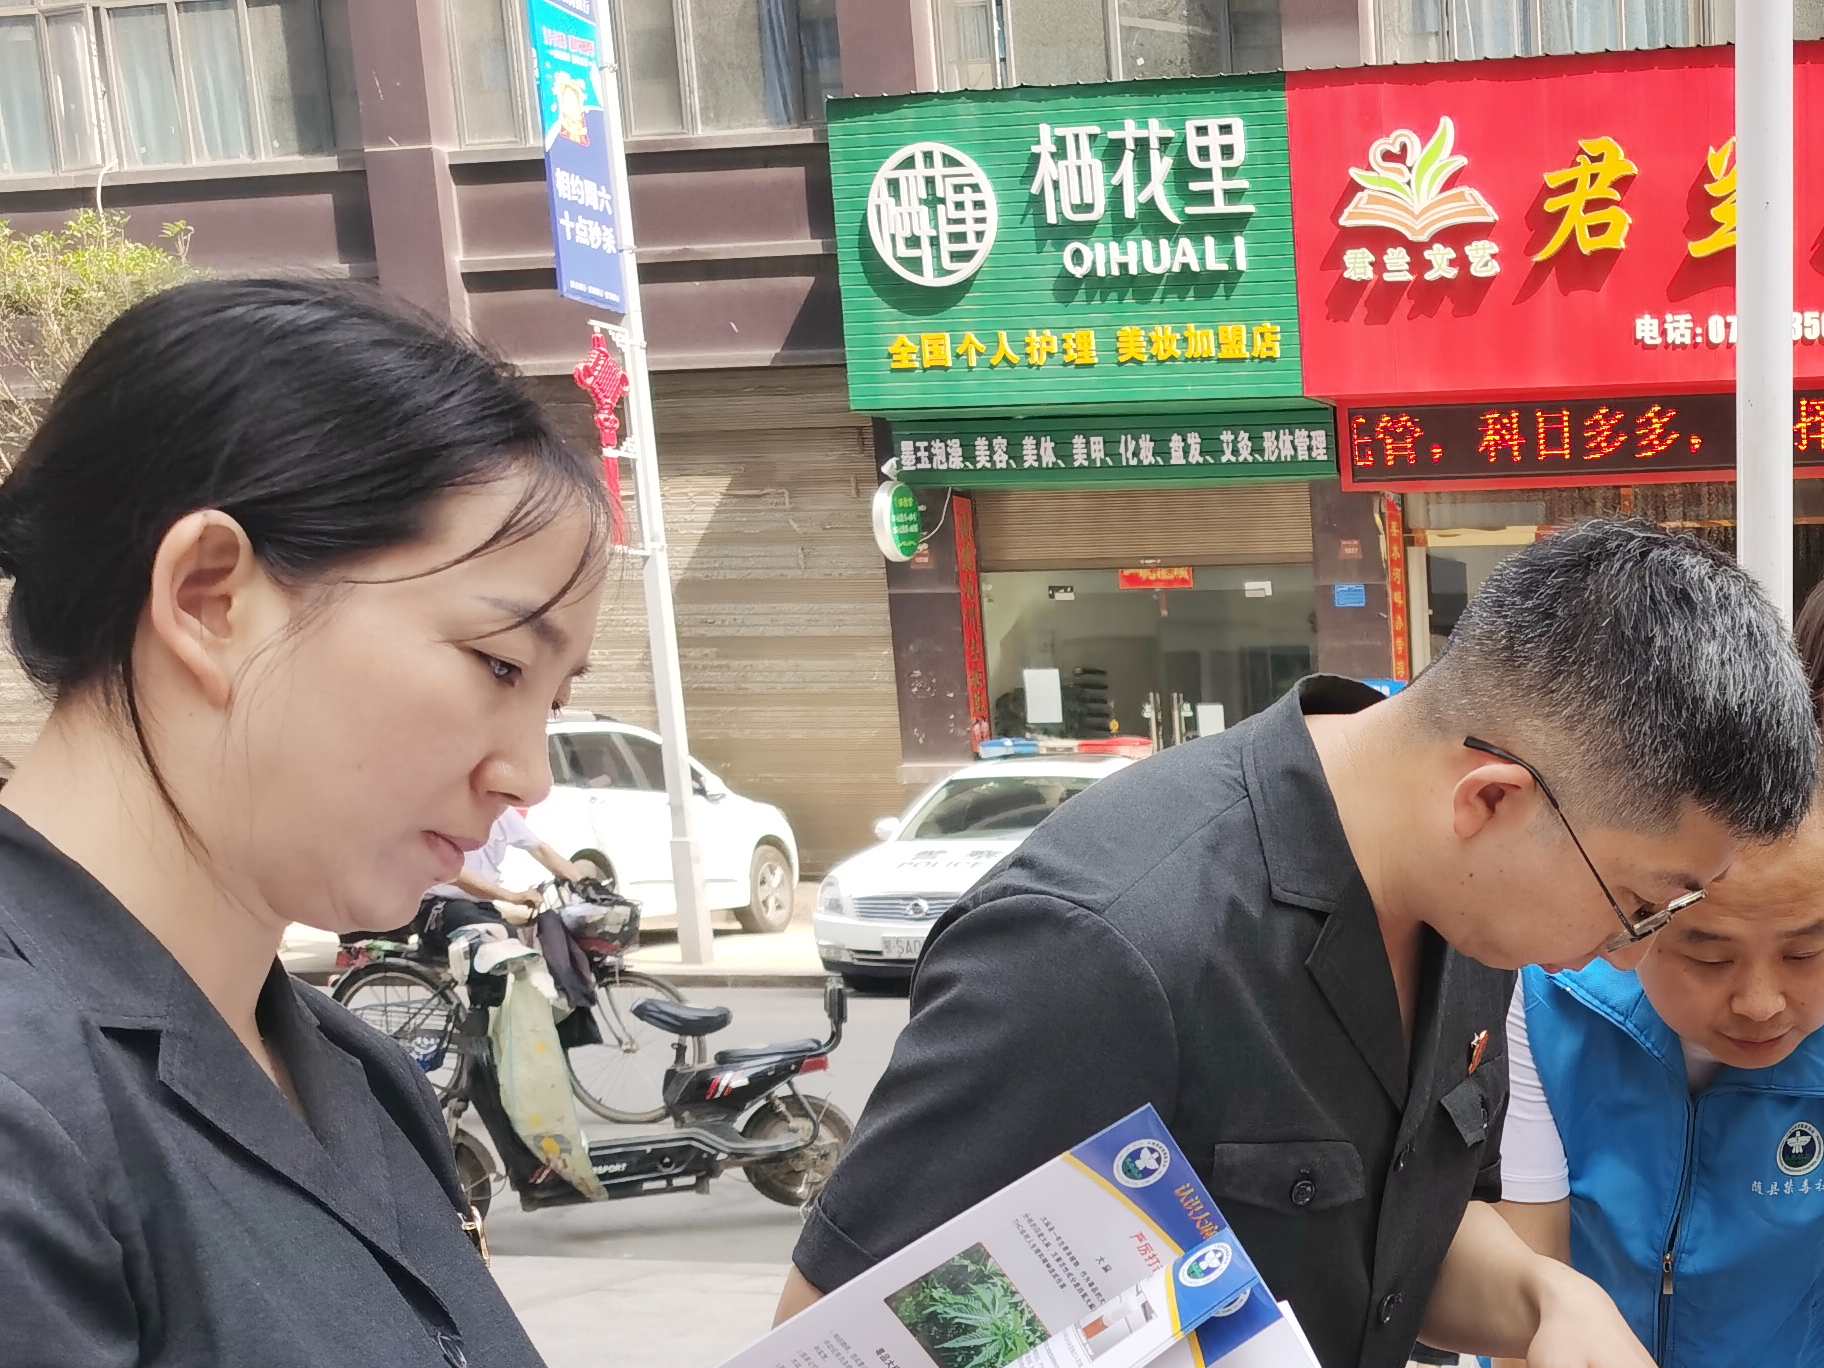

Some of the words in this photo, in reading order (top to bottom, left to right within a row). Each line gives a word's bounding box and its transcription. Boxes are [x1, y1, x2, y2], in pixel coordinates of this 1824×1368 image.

[1030, 117, 1256, 225] 栖花里
[1063, 236, 1247, 279] QIHUALI
[1342, 244, 1501, 281] 君兰文艺
[887, 328, 1099, 370] 全国个人护理
[1115, 323, 1281, 364] 美妆加盟店
